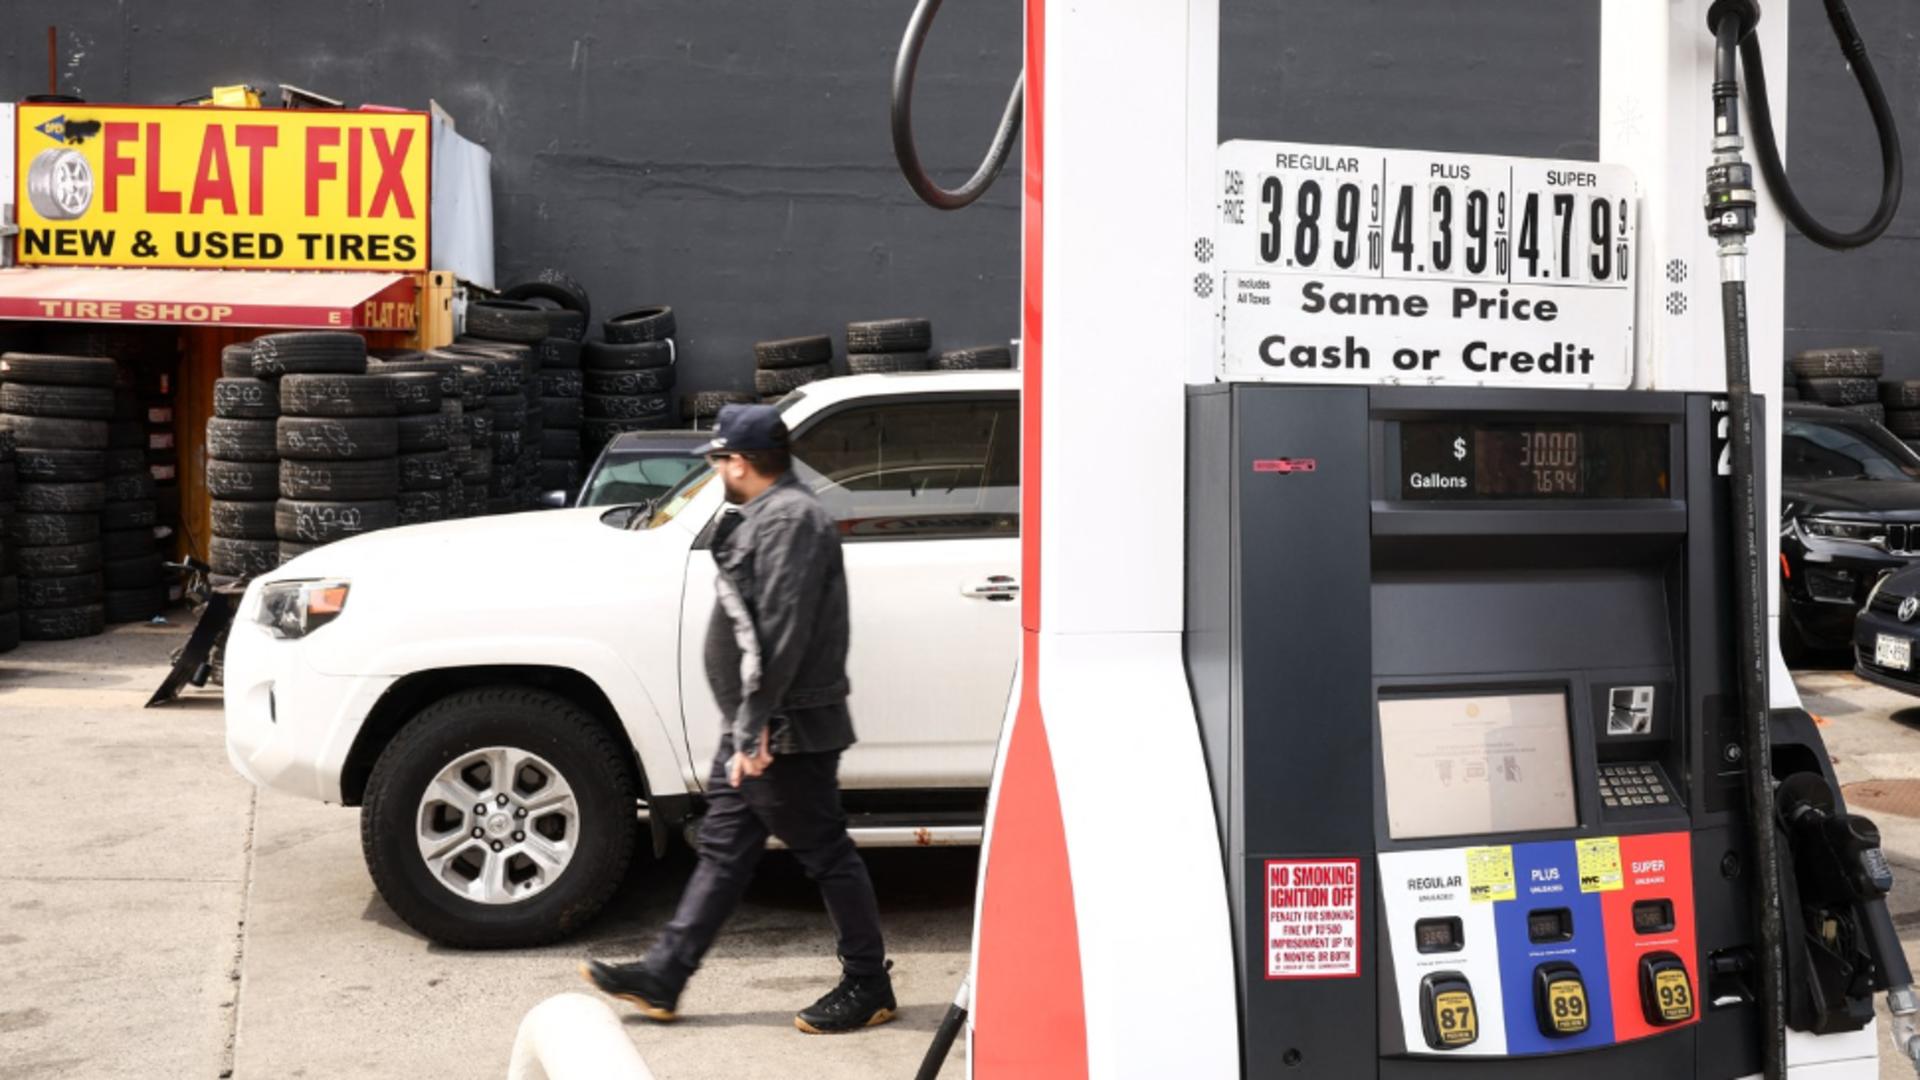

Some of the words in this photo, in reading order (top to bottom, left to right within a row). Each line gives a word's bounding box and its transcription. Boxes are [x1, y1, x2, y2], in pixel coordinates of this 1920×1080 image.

[103, 122, 278, 215] FLAT
[304, 127, 415, 218] FIX
[1276, 154, 1359, 173] REGULAR
[1430, 163, 1471, 180] PLUS
[1546, 170, 1597, 187] SUPER
[1261, 175, 1360, 269] 3.89
[1391, 185, 1489, 275] 4.39
[24, 228, 116, 256] NEW
[131, 230, 159, 258] &
[176, 231, 283, 259] USED
[299, 233, 416, 261] TIRES
[1238, 279, 1271, 290] Includes
[1237, 293, 1248, 303] All
[1249, 294, 1271, 305] Taxes
[1302, 281, 1429, 317] Same
[1452, 287, 1559, 321] Price
[39, 300, 122, 320] TIRE
[134, 303, 233, 322] SHOP
[328, 311, 341, 324] E
[365, 301, 394, 328] FLAT
[1258, 335, 1370, 369] Cash
[1392, 348, 1440, 371] or
[1462, 341, 1595, 374] Credit
[1453, 436, 1467, 461] $
[1410, 472, 1468, 488] Gallons
[1531, 868, 1560, 881] PLUS
[1631, 860, 1665, 873] SUPER
[1271, 867, 1289, 886] NO
[1293, 866, 1354, 886] SMOKING
[1407, 875, 1462, 890] REGULAR
[1581, 876, 1600, 885] NYC
[1271, 888, 1329, 908] IGNITION
[1332, 887, 1354, 906] OFF
[1471, 886, 1490, 894] NYC
[1271, 911, 1302, 922] PENALTY
[1304, 911, 1318, 921] FOR
[1320, 910, 1354, 921] SMOKING
[1283, 925, 1300, 935] FINE
[1302, 925, 1313, 935] UP
[1271, 938, 1329, 949] IMPRISONMENT
[1284, 951, 1316, 962] MONTHS
[1330, 951, 1350, 961] BOTH
[1660, 985, 1688, 1007] 93
[1554, 996, 1583, 1018] 89
[1441, 1006, 1469, 1029] 87
